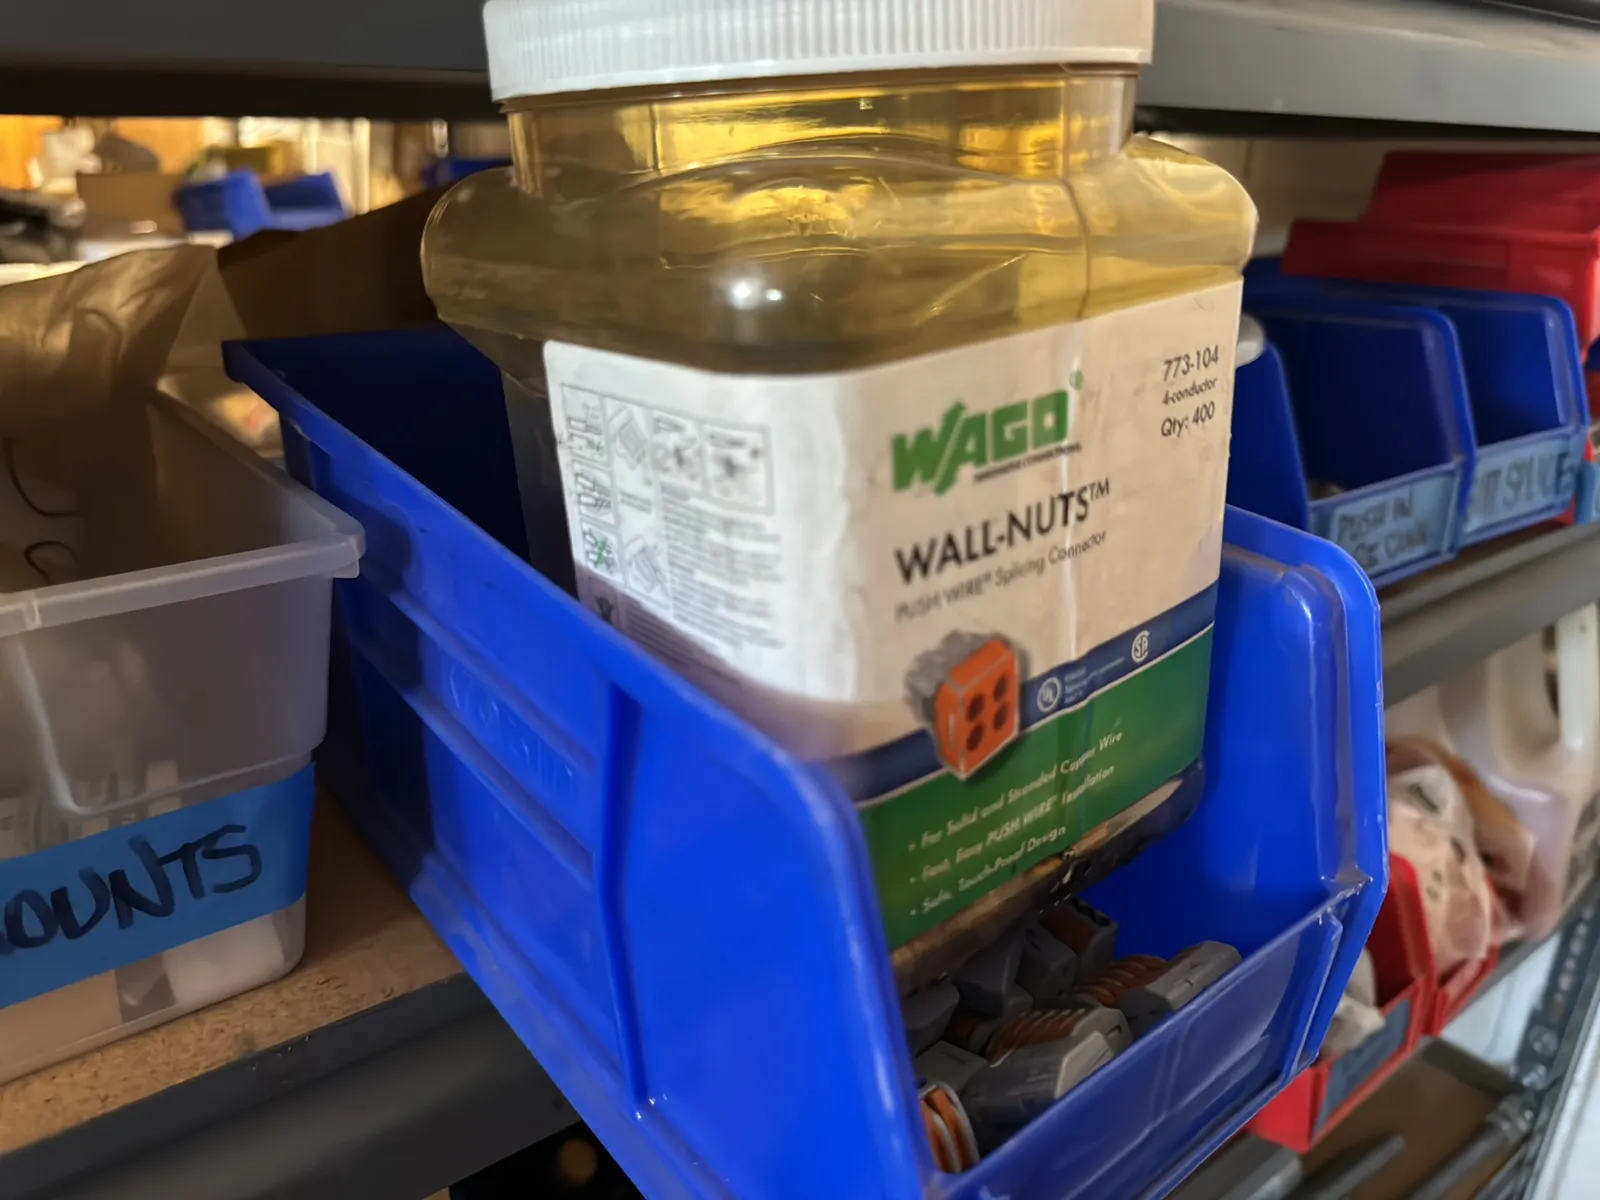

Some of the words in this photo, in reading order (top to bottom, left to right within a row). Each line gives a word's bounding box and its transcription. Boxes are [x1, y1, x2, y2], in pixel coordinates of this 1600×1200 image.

[1163, 344, 1219, 382] 773-104
[1162, 378, 1218, 405] 4-conductor
[1160, 416, 1189, 438] Qty:
[1192, 400, 1216, 424] 400
[995, 556, 1046, 589] Splicing
[1049, 531, 1107, 564] Connector
[1099, 731, 1124, 752] Wire
[0, 824, 262, 957] OUNTS
